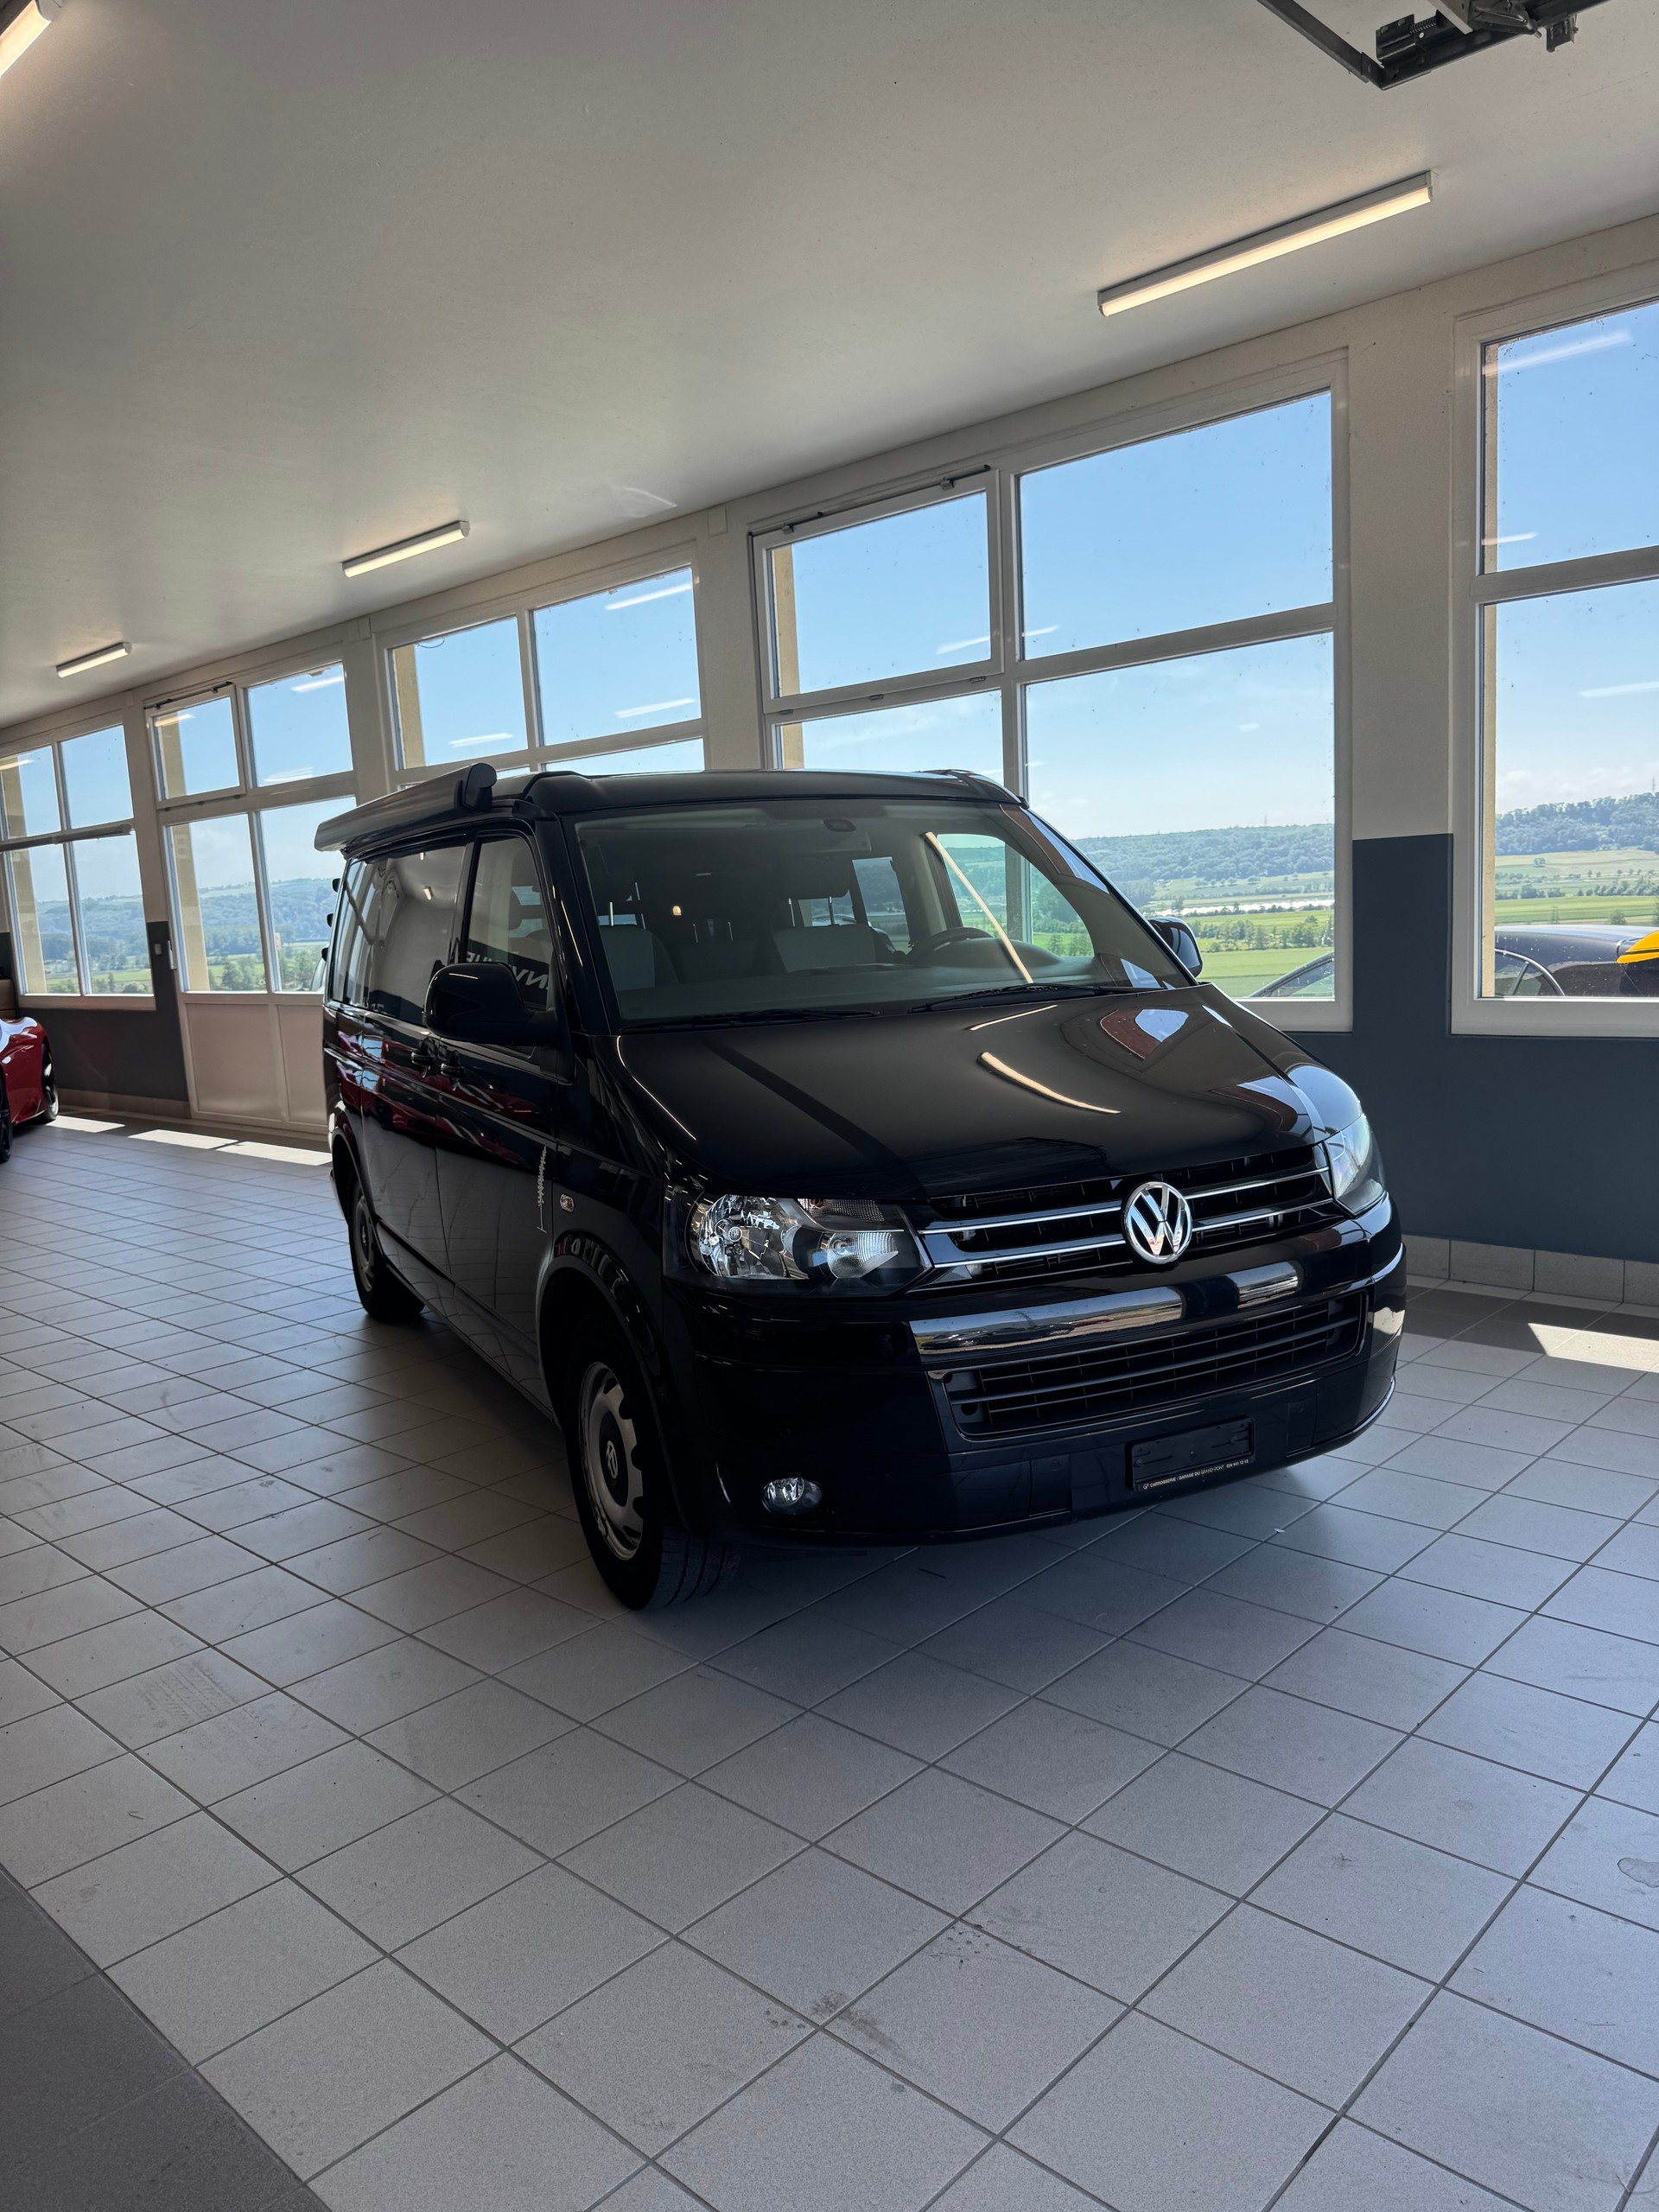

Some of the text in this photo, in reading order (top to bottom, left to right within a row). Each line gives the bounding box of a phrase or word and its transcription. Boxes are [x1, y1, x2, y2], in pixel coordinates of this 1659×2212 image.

[1126, 1183, 1190, 1261] VW
[1149, 1476, 1176, 1488] CARROSSERIE
[1178, 1471, 1194, 1480] GARAGE
